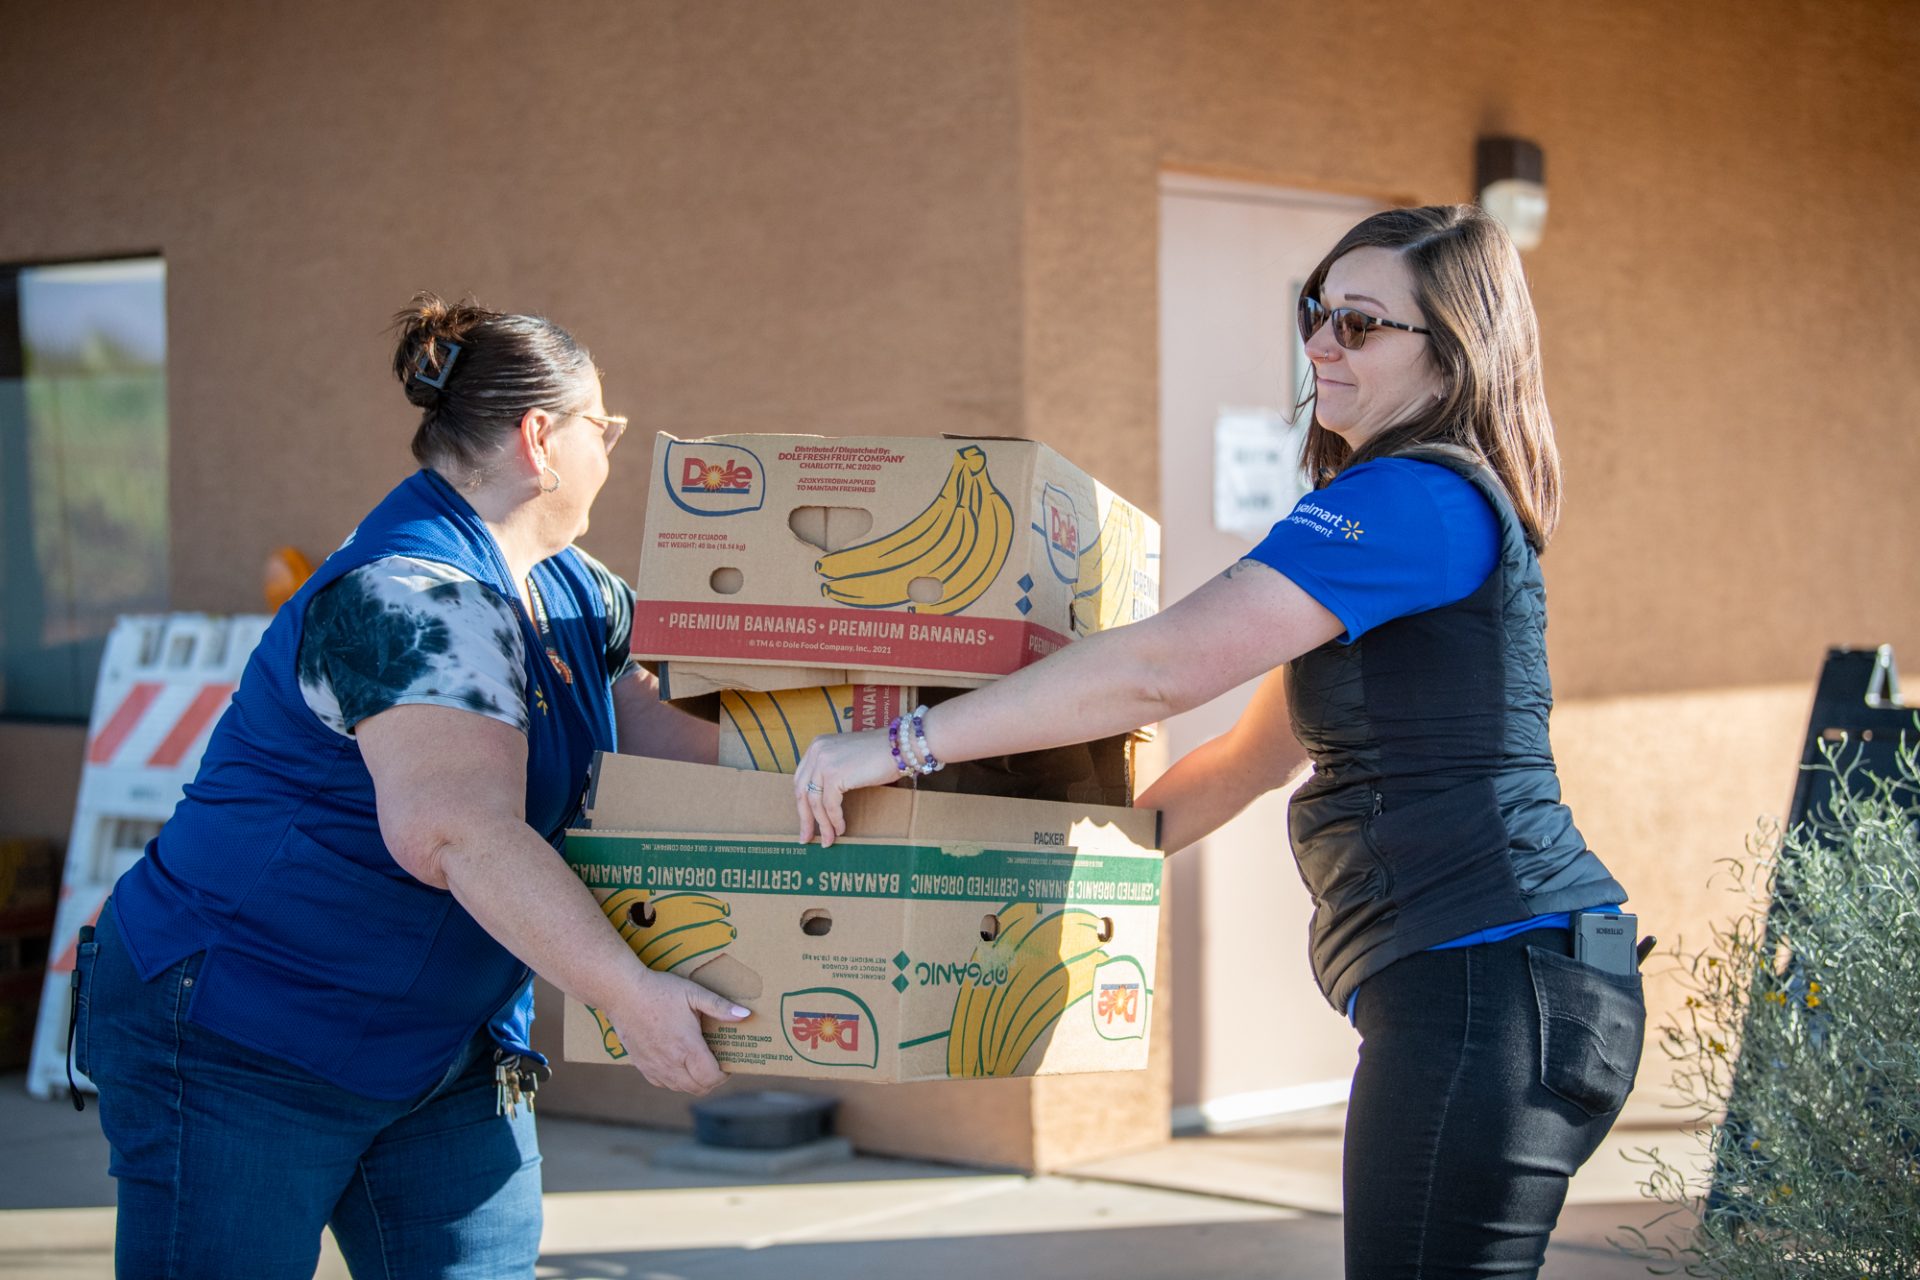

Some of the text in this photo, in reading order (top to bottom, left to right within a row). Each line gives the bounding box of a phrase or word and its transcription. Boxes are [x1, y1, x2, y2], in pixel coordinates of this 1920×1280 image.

[832, 454, 857, 462] FRUIT
[858, 454, 904, 464] COMPANY
[839, 446, 878, 455] Dispatched
[878, 448, 890, 456] By:
[681, 458, 752, 489] Dole
[1051, 506, 1076, 552] Dole
[669, 612, 986, 646] PREMIUM BANANAS PREMIUM BANANAS
[820, 642, 854, 652] Company,
[872, 645, 891, 654] 2021
[862, 685, 876, 731] ANAN
[1034, 832, 1064, 846] PACKER
[647, 866, 717, 887] ORGANIC
[721, 868, 802, 890] CERTIFIED
[819, 872, 900, 893] BANANAS
[911, 874, 1154, 901] CERTIFIED ORGANIC BANANAS CERTIFIED ORGANIC
[1098, 989, 1139, 1024] Dole
[792, 1017, 858, 1051] Dole
